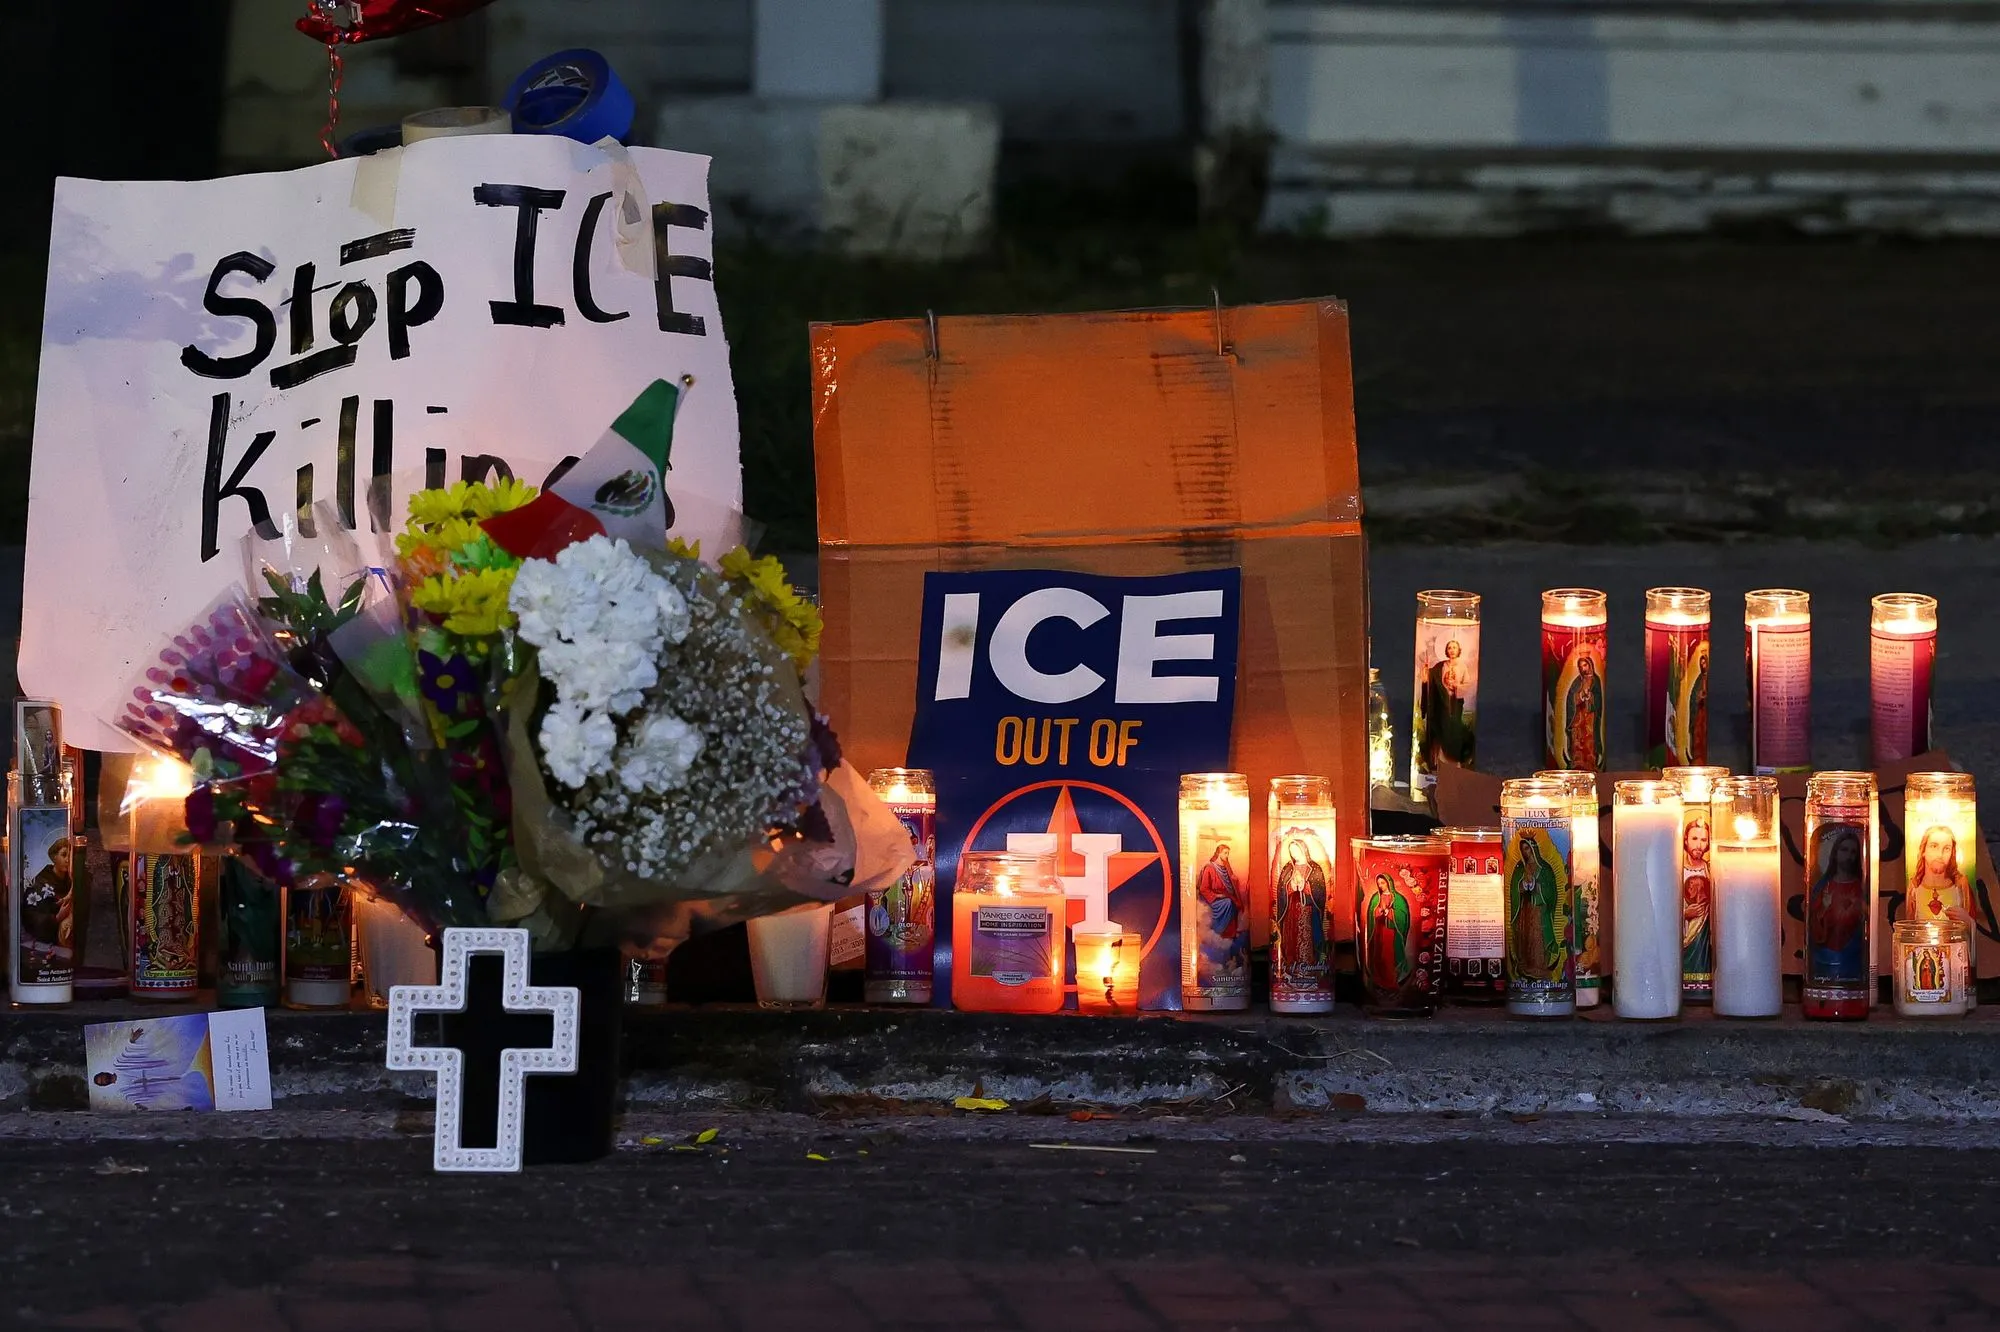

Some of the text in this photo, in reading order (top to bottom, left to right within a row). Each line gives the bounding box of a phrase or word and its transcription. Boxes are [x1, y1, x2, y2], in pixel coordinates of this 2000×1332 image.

[180, 182, 712, 388] Stop ICE
[934, 587, 1225, 704] ICE
[995, 716, 1144, 768] OUT OF
[1438, 871, 1448, 889] FE
[1437, 893, 1447, 913] TU
[981, 920, 1043, 929] HOME INSPIRATION
[1435, 916, 1446, 938] DE
[1433, 942, 1445, 973] LUZ
